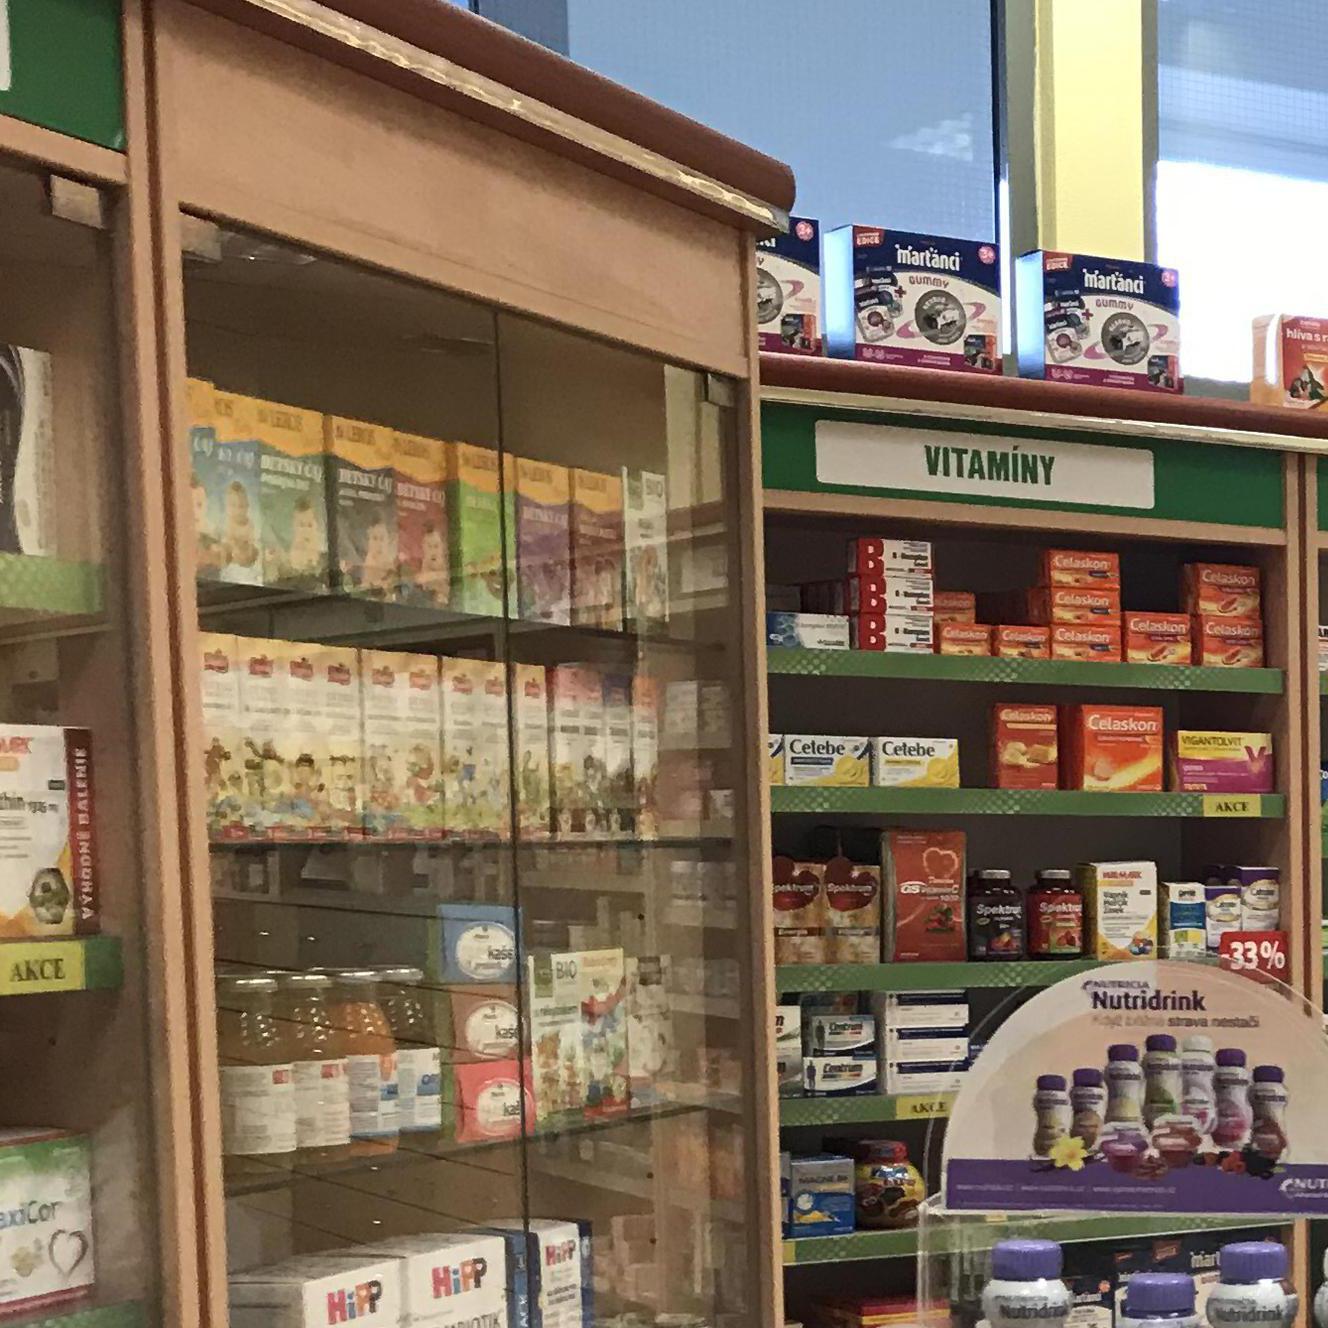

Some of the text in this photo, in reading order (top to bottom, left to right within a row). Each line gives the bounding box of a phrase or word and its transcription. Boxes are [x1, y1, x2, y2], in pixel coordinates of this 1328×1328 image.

[925, 445, 1055, 486] VITAMÍNY
[1089, 714, 1158, 733] Celaskon
[790, 739, 845, 756] Cetebe
[882, 741, 935, 758] Cetebe
[1216, 801, 1249, 812] AKCE
[10, 958, 64, 982] AKCE
[1092, 990, 1206, 1011] Nutridrink
